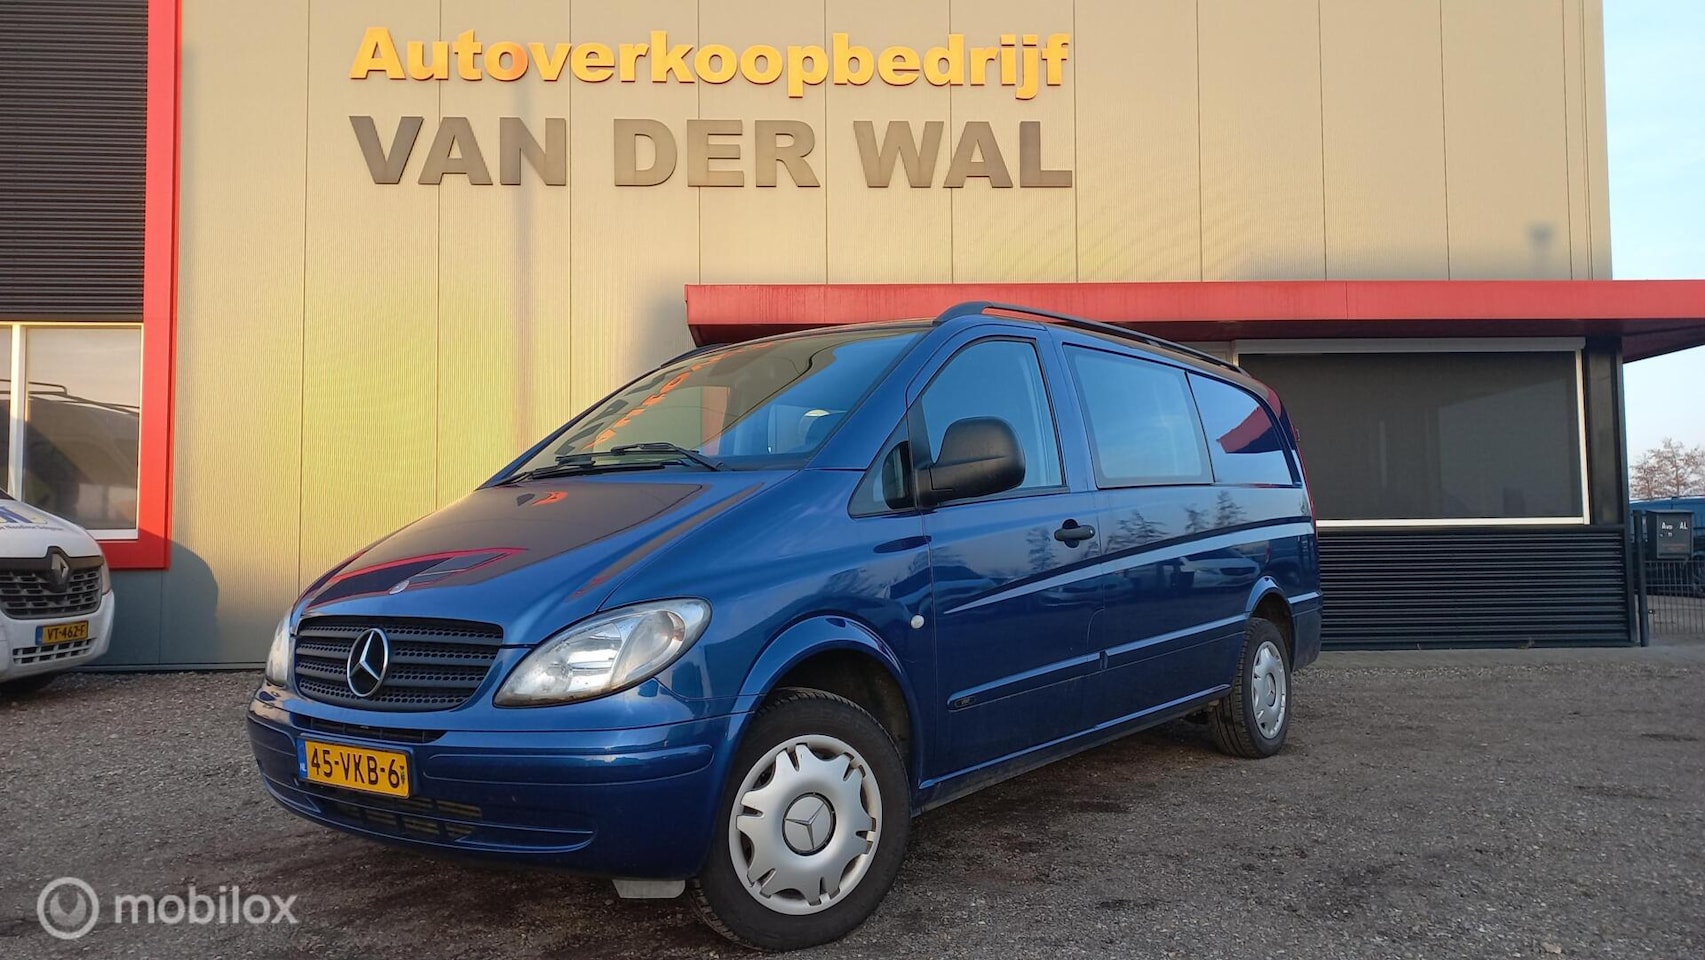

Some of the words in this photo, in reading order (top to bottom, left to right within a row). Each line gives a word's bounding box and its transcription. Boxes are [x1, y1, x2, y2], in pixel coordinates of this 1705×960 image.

[349, 26, 1072, 100] Autoverkoopbedrijf
[349, 116, 567, 187] VAN
[613, 118, 821, 187] DER
[853, 120, 1073, 188] WAL
[47, 625, 85, 641] VT-462-F
[311, 747, 400, 789] 45-VKB-6
